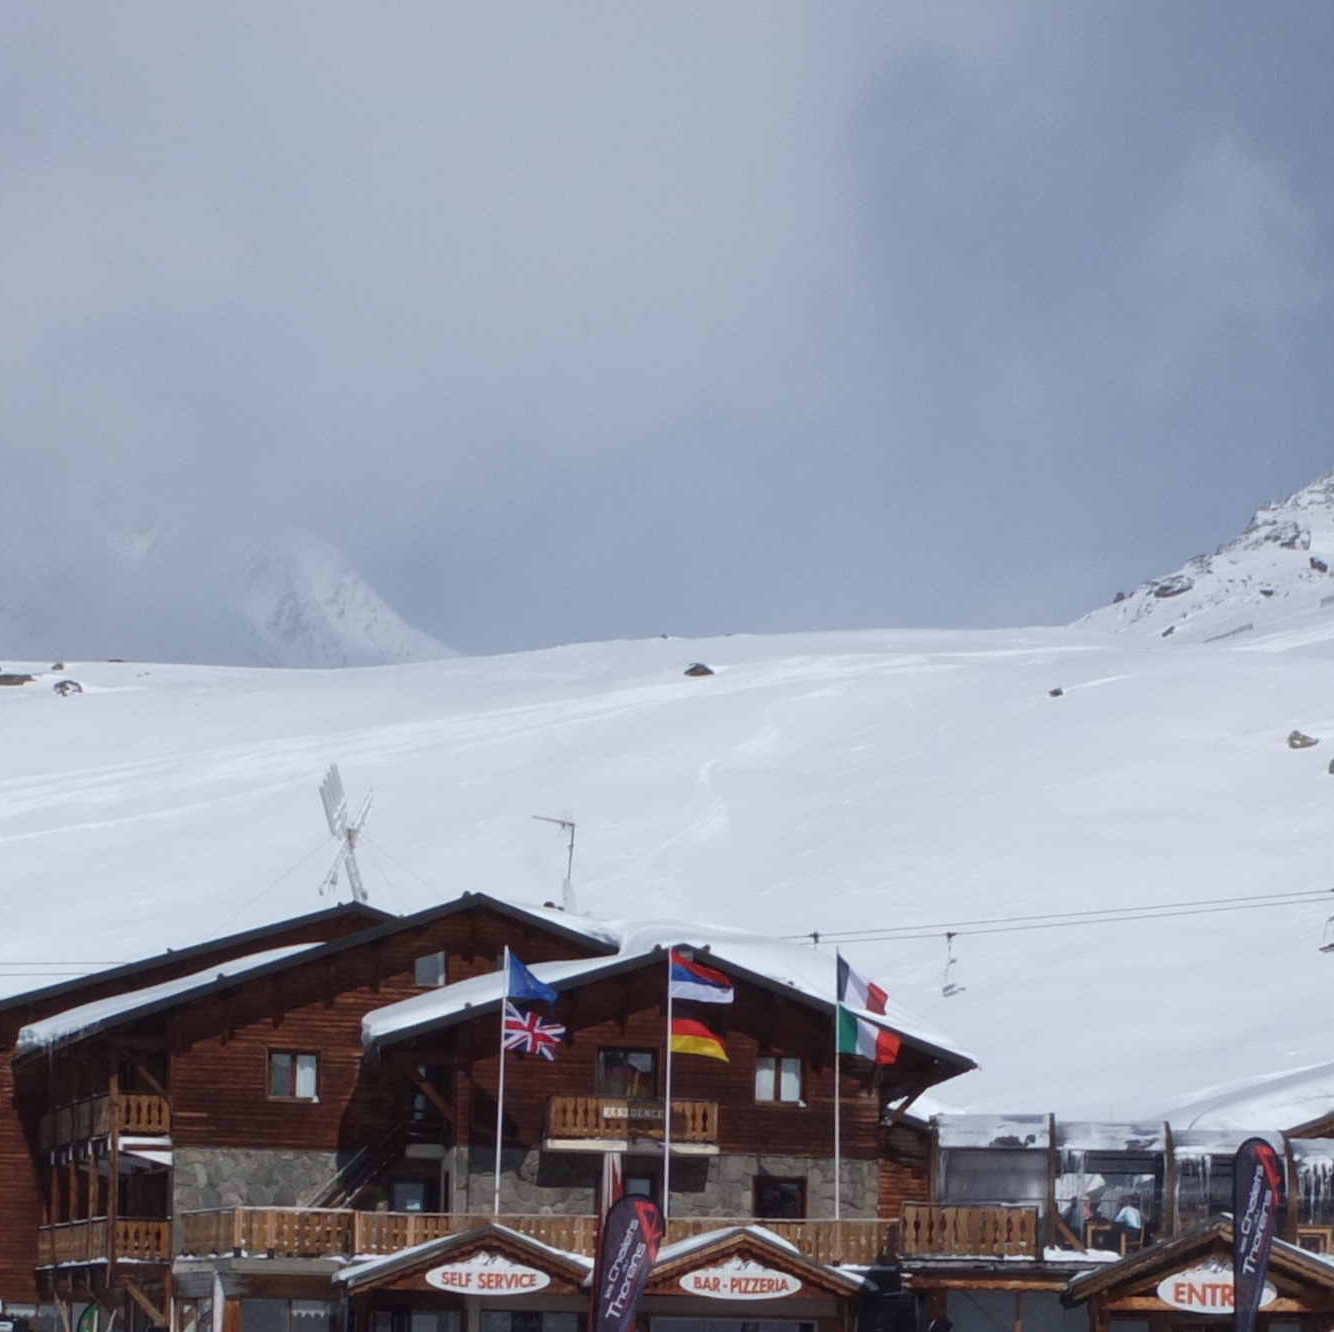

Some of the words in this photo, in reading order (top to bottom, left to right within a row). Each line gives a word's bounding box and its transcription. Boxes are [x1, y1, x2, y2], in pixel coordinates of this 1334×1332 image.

[441, 1271, 473, 1288] SELF
[478, 1272, 537, 1290] SERVICE
[605, 1242, 647, 1320] Thorens
[693, 1276, 721, 1292] BAR
[730, 1276, 789, 1294] PIZZERIA
[1173, 1282, 1235, 1308] ENTR
